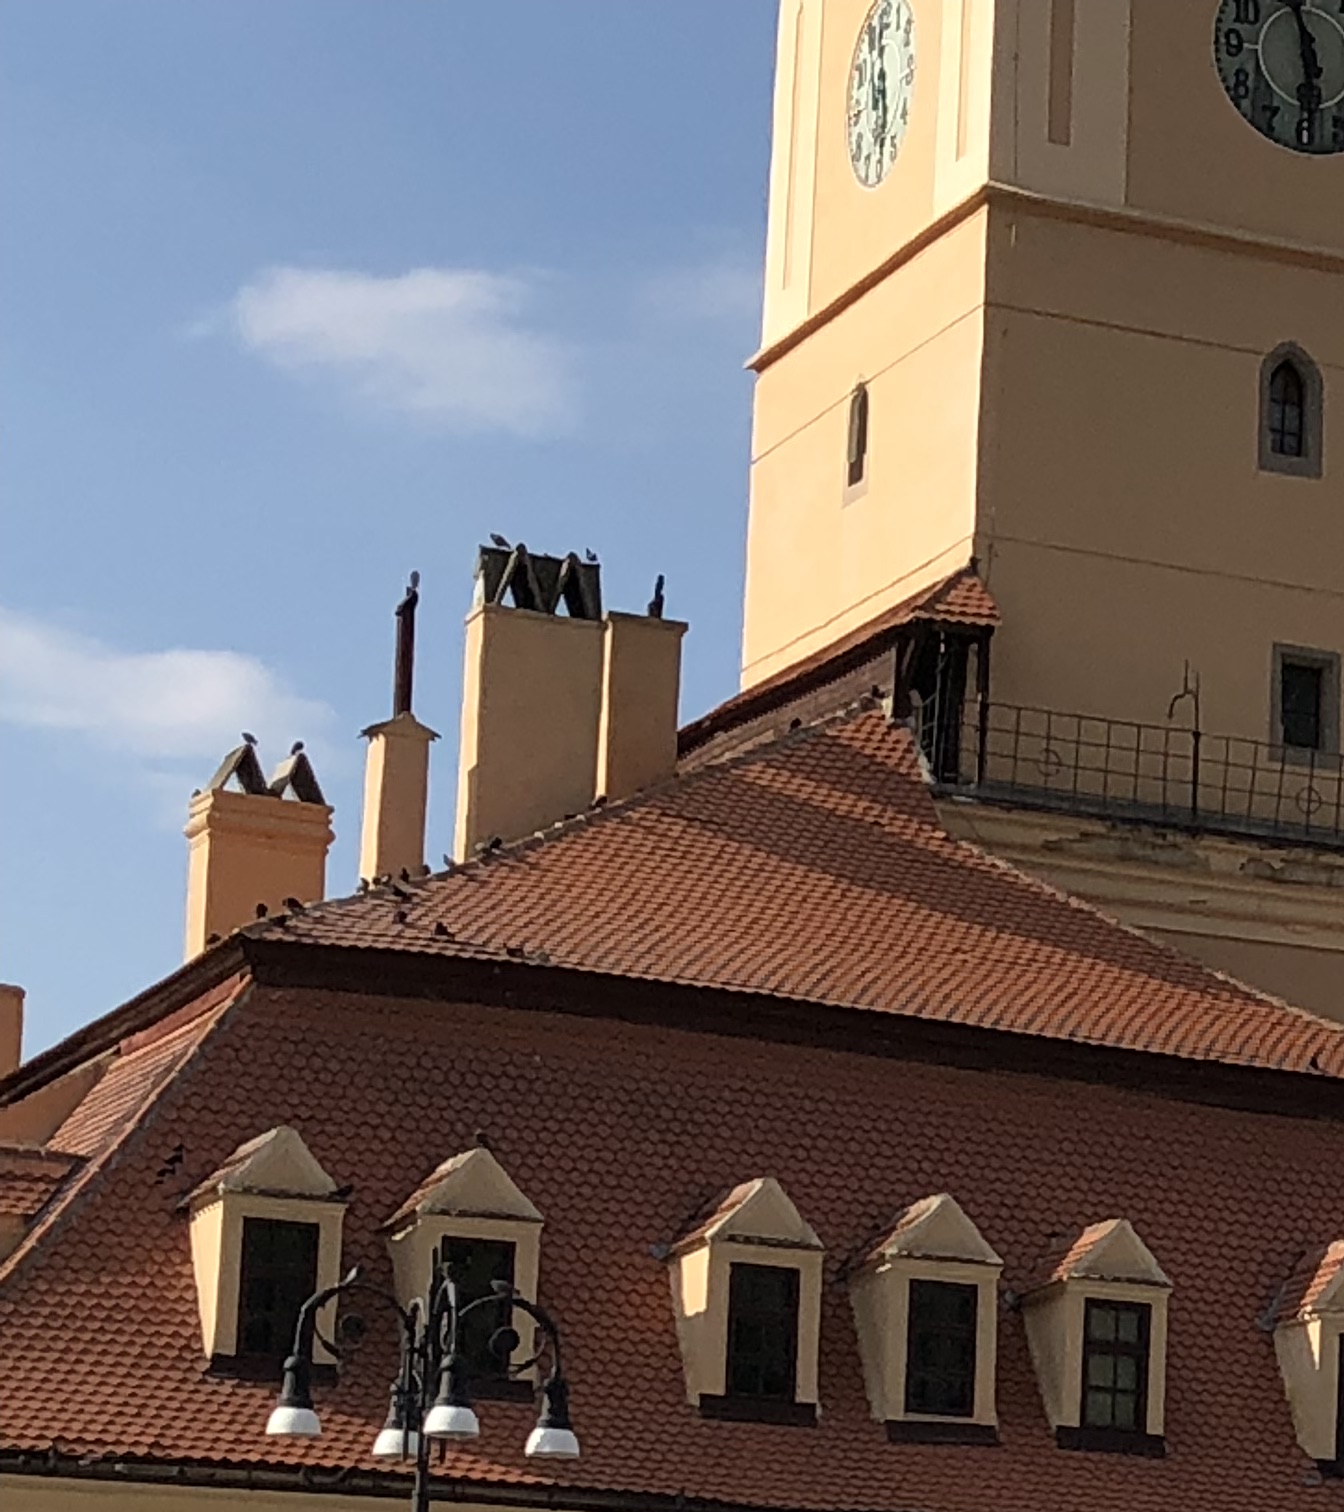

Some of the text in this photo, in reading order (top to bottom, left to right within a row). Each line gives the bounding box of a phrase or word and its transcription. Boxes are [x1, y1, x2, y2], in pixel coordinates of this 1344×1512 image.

[1225, 28, 1243, 57] 9
[1233, 68, 1250, 99] 8
[1262, 104, 1281, 133] 7
